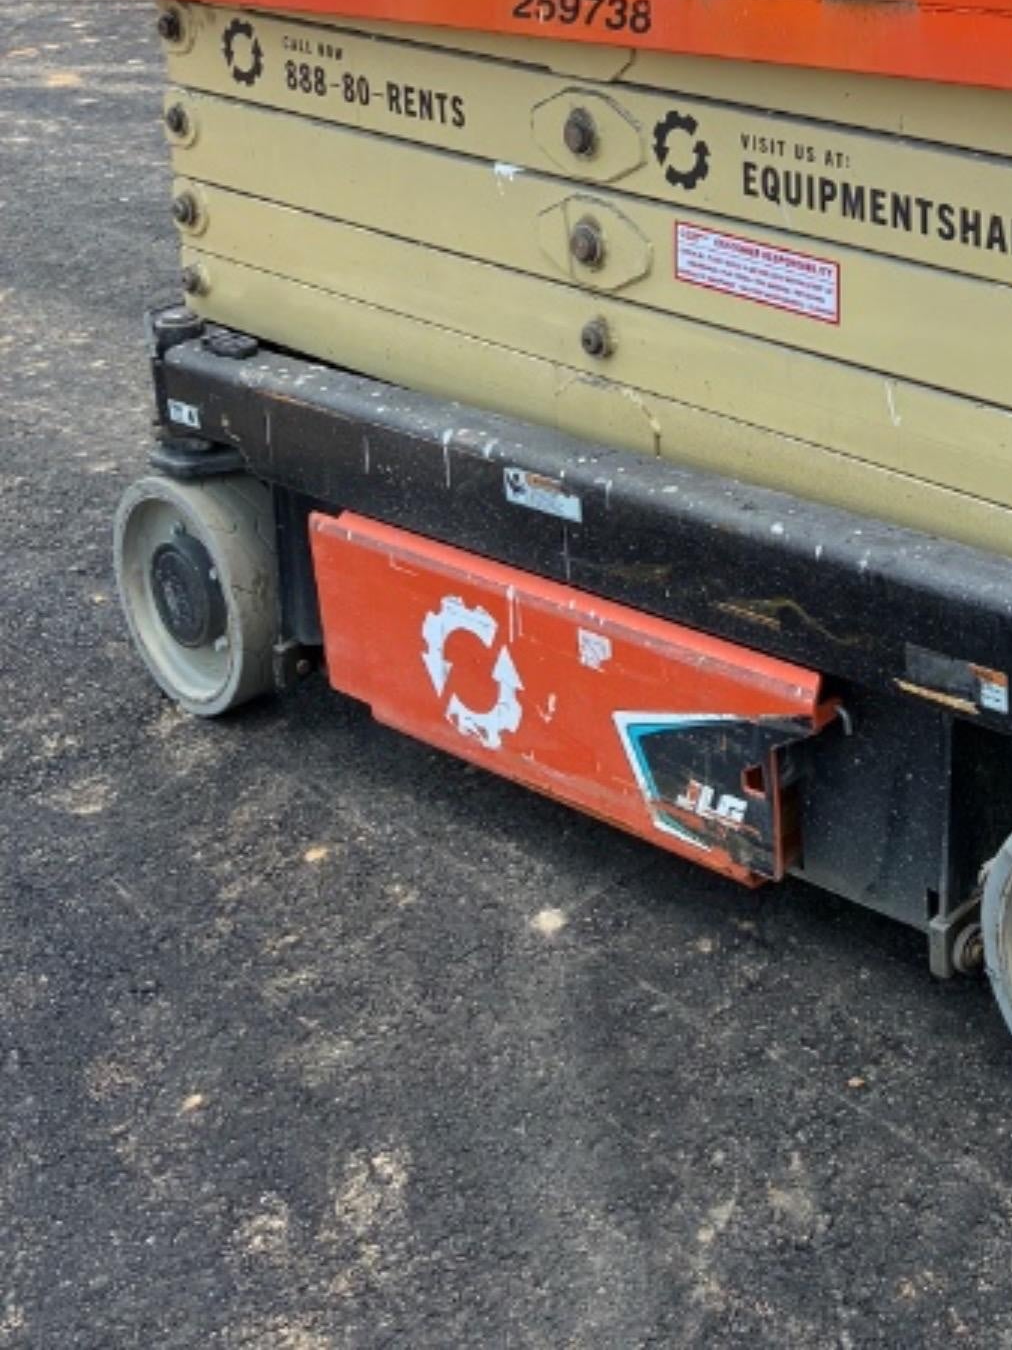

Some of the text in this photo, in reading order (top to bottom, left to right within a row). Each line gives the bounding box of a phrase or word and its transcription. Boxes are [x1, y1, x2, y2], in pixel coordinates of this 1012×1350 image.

[284, 59, 466, 129] 888-80-RENTS
[740, 133, 852, 170] VISIT US AT:
